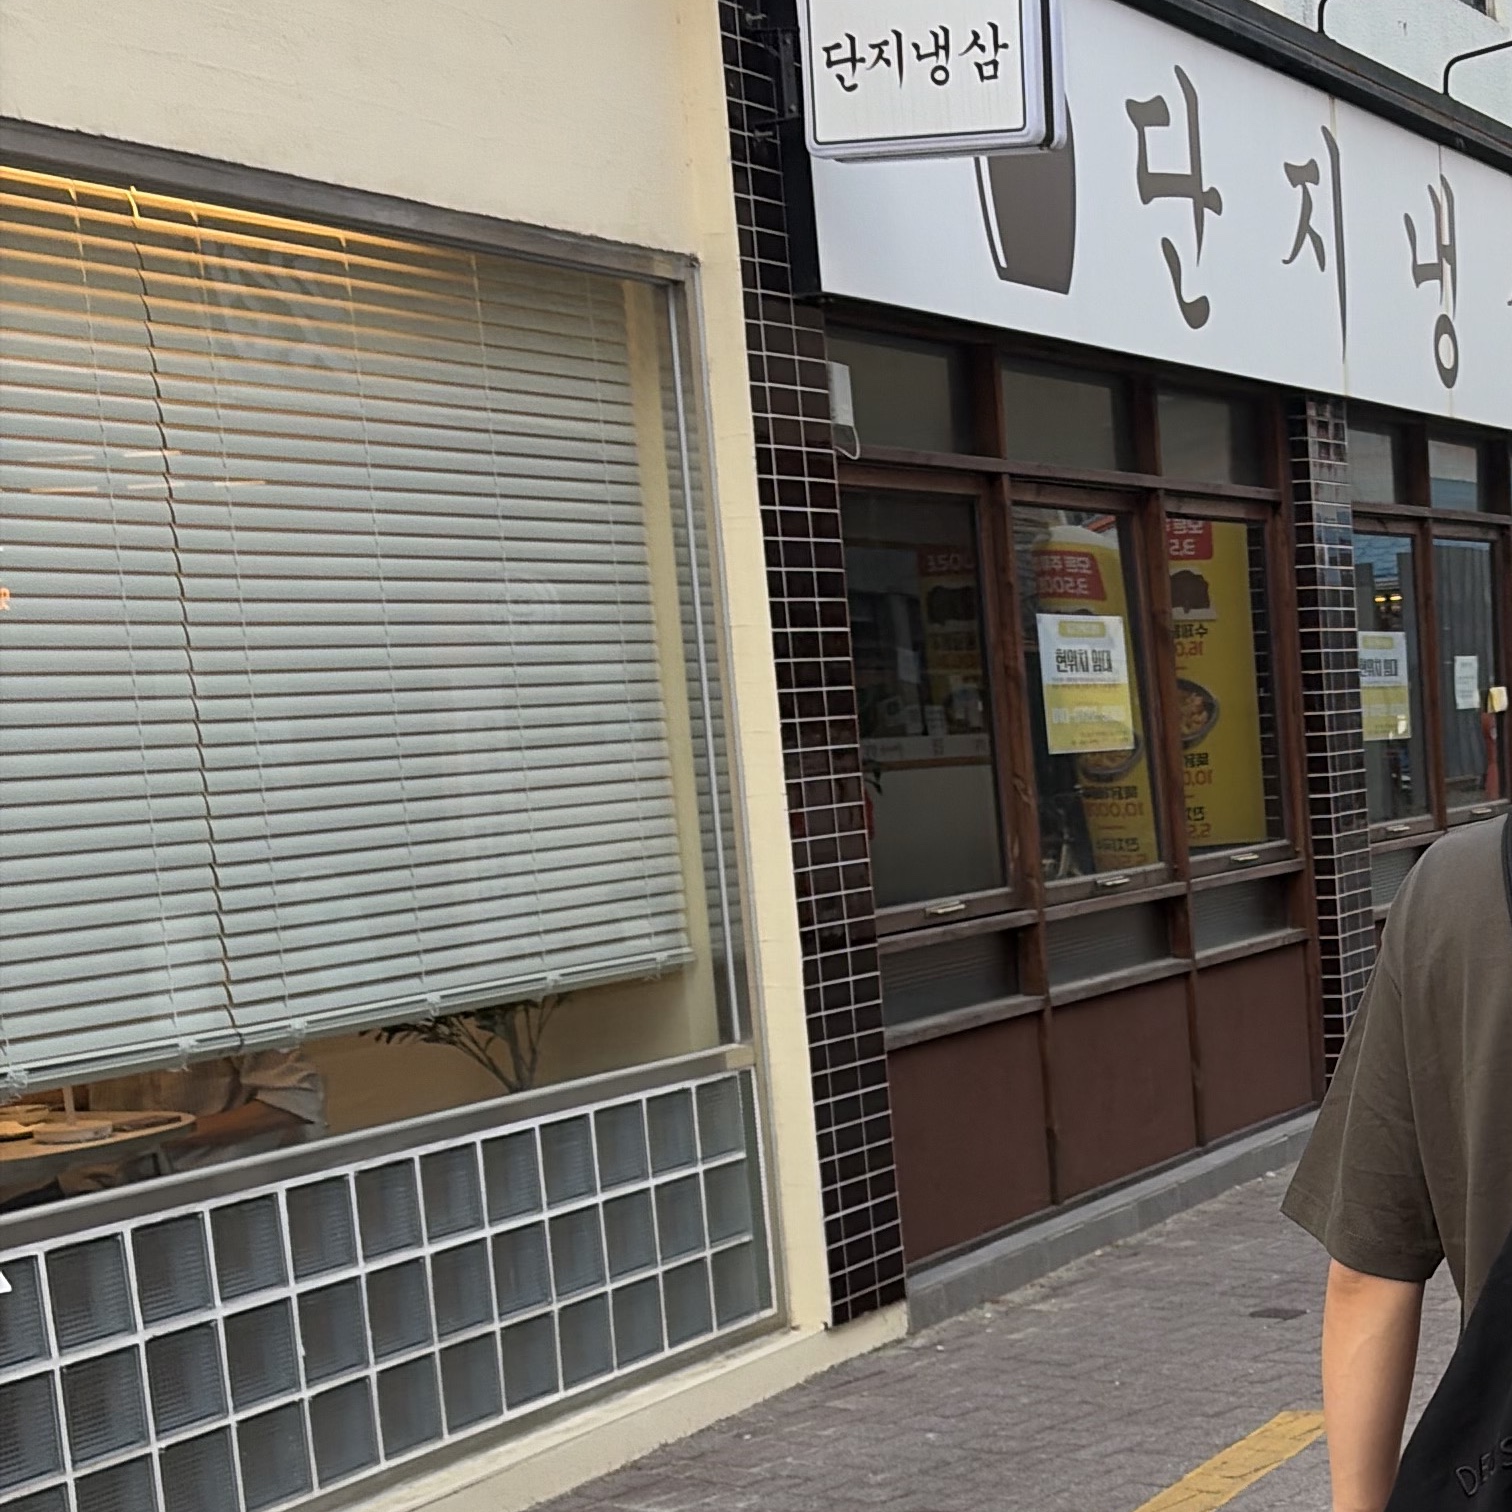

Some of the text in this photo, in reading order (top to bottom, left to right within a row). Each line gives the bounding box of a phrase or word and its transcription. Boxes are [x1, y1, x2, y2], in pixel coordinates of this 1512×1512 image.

[822, 21, 1010, 93] 단지냉삼
[1055, 648, 1113, 673] 현위치 임대
